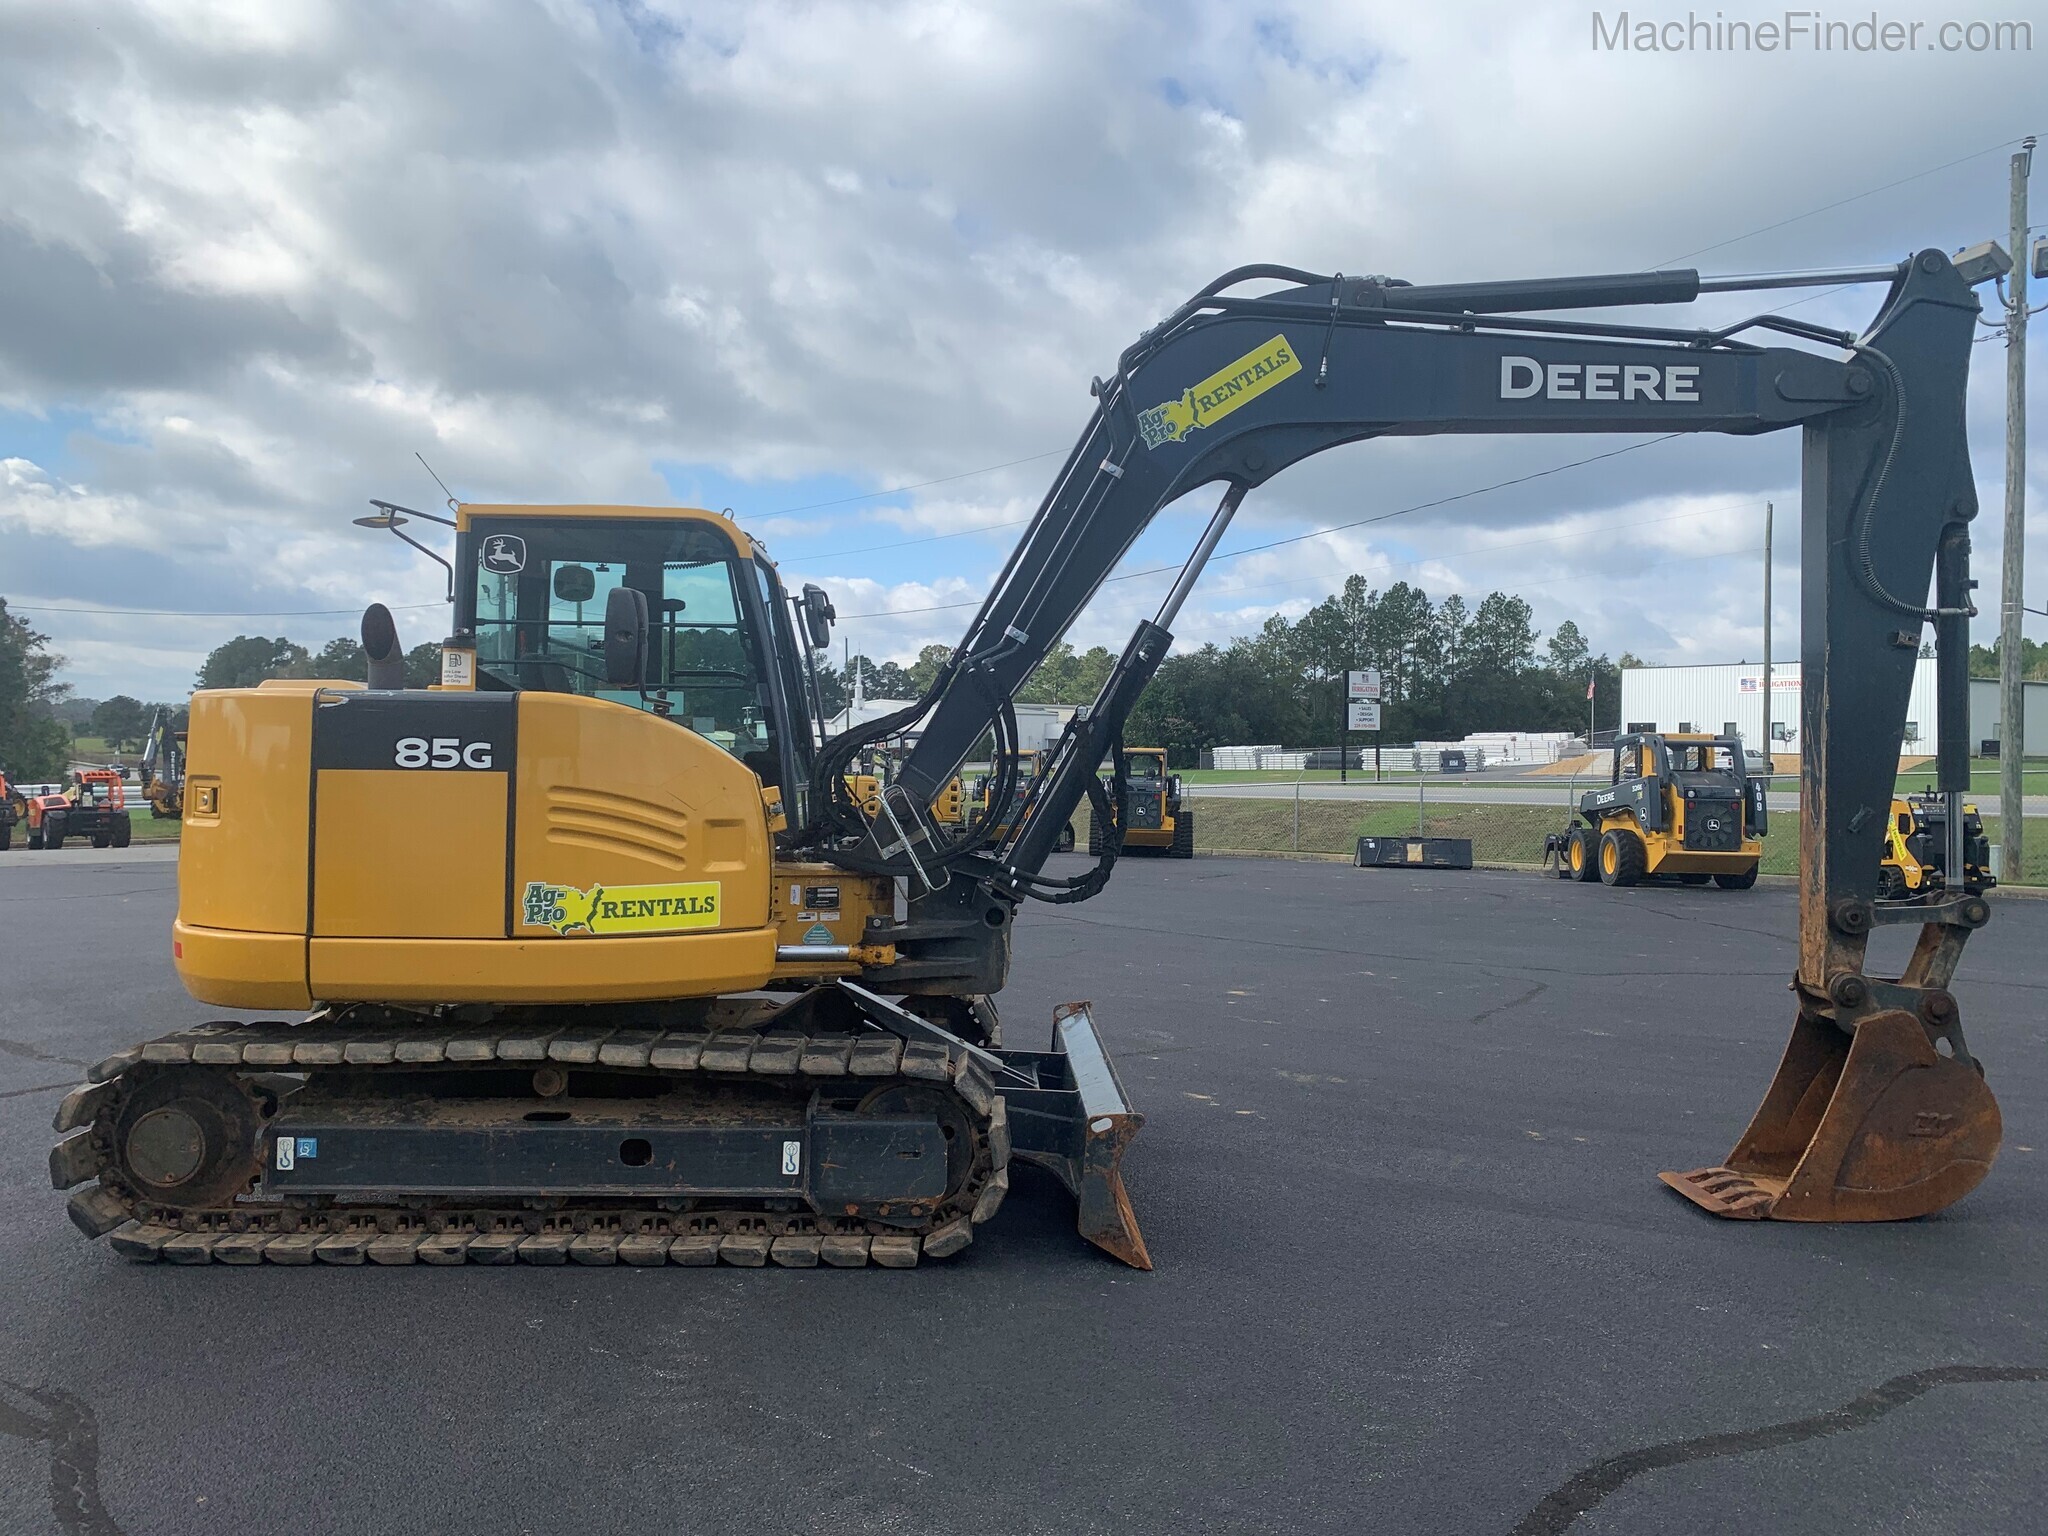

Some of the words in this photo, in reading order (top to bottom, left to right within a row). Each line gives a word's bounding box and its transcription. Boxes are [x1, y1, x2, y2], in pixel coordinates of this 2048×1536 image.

[1197, 348, 1291, 413] RENTALS
[1500, 356, 1700, 402] DEERE
[1144, 421, 1177, 447] Pro
[395, 737, 492, 769] 85G
[1596, 791, 1615, 805] DEERE
[1755, 782, 1763, 812] 409
[526, 885, 566, 907] Ag-
[601, 896, 716, 919] RENTALS
[526, 905, 566, 924] Pro
